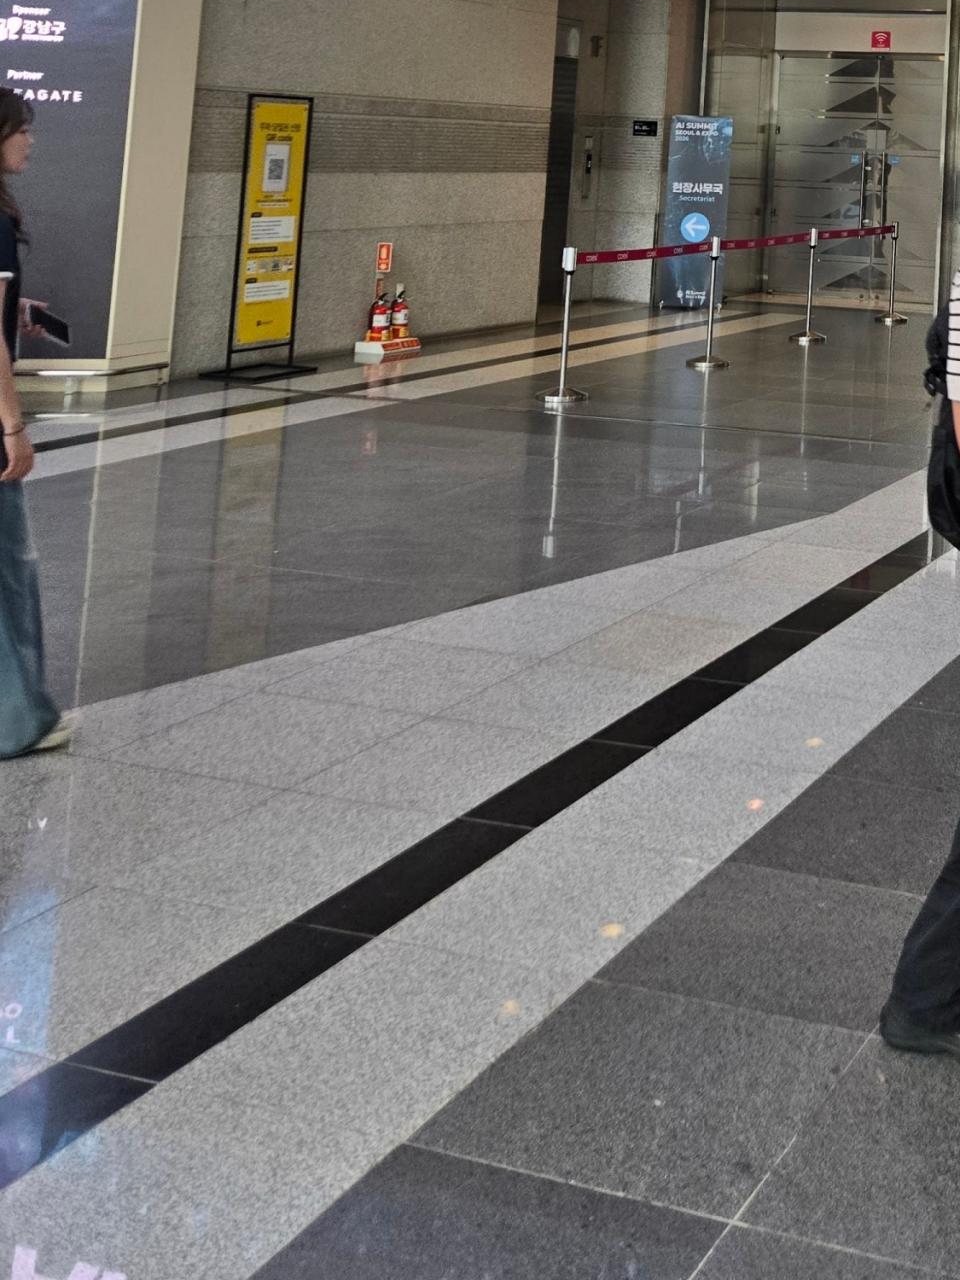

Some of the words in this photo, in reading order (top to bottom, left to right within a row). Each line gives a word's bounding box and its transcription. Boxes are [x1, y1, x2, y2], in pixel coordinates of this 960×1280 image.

[22, 19, 67, 35] 강남구
[13, 88, 83, 102] AGATE
[686, 122, 718, 131] SUMMIT
[672, 181, 724, 195] 현장사무국
[679, 194, 716, 203] Secretariat
